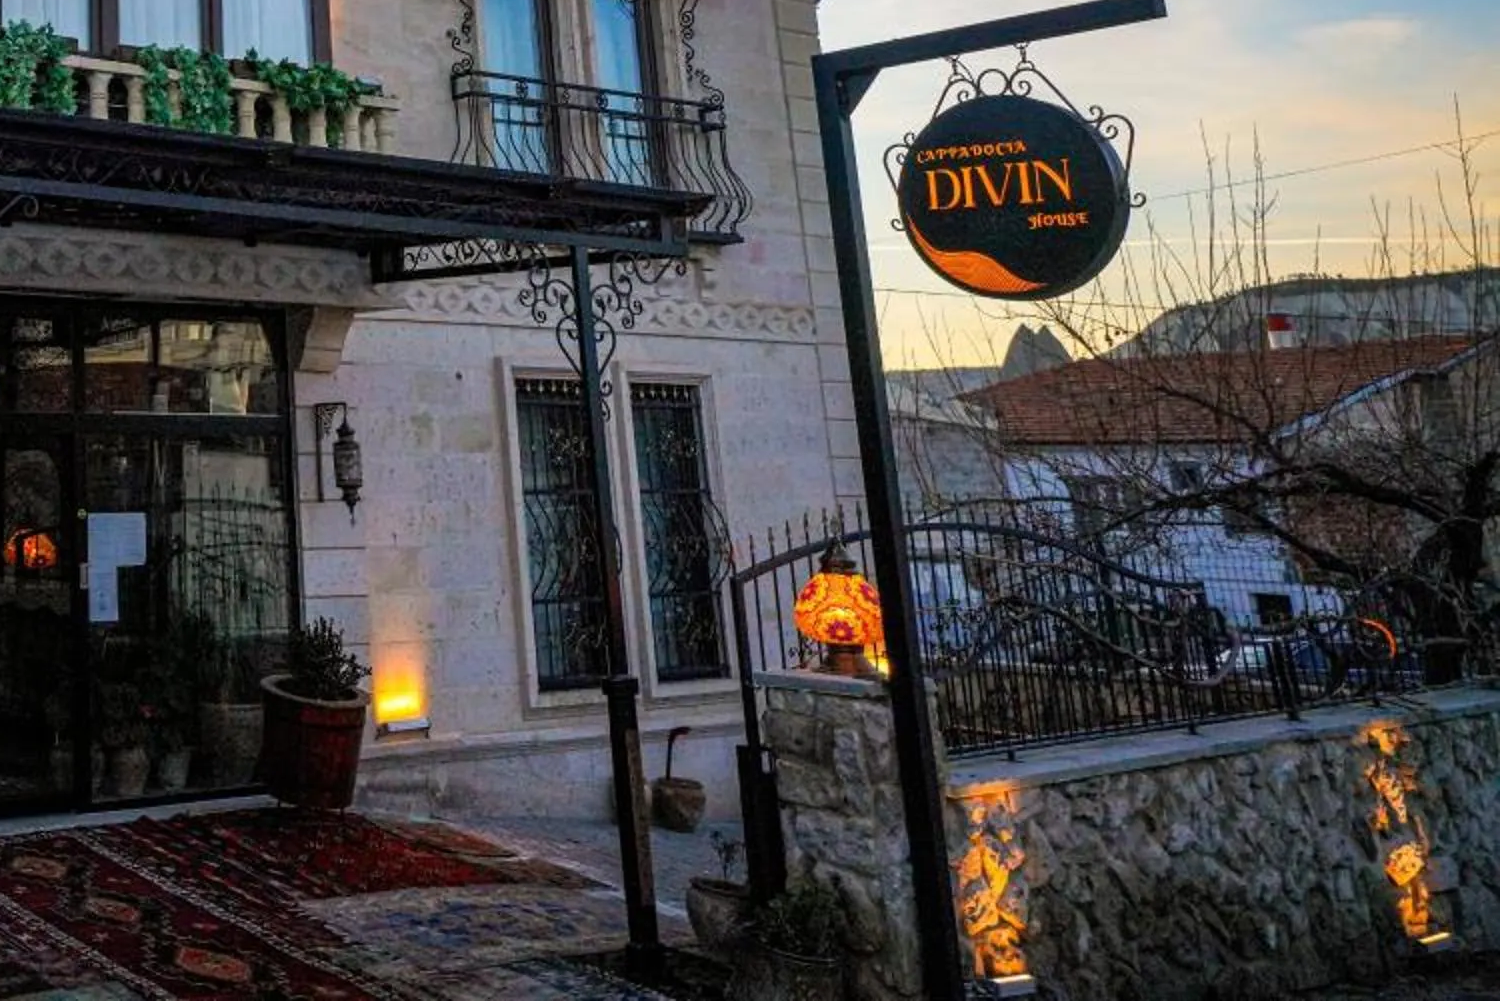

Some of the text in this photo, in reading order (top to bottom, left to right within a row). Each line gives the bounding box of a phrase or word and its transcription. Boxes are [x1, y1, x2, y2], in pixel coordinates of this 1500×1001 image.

[917, 140, 1026, 164] CAPPADOCIA
[923, 159, 1072, 210] DIVIN
[1029, 213, 1089, 230] HOUSE
